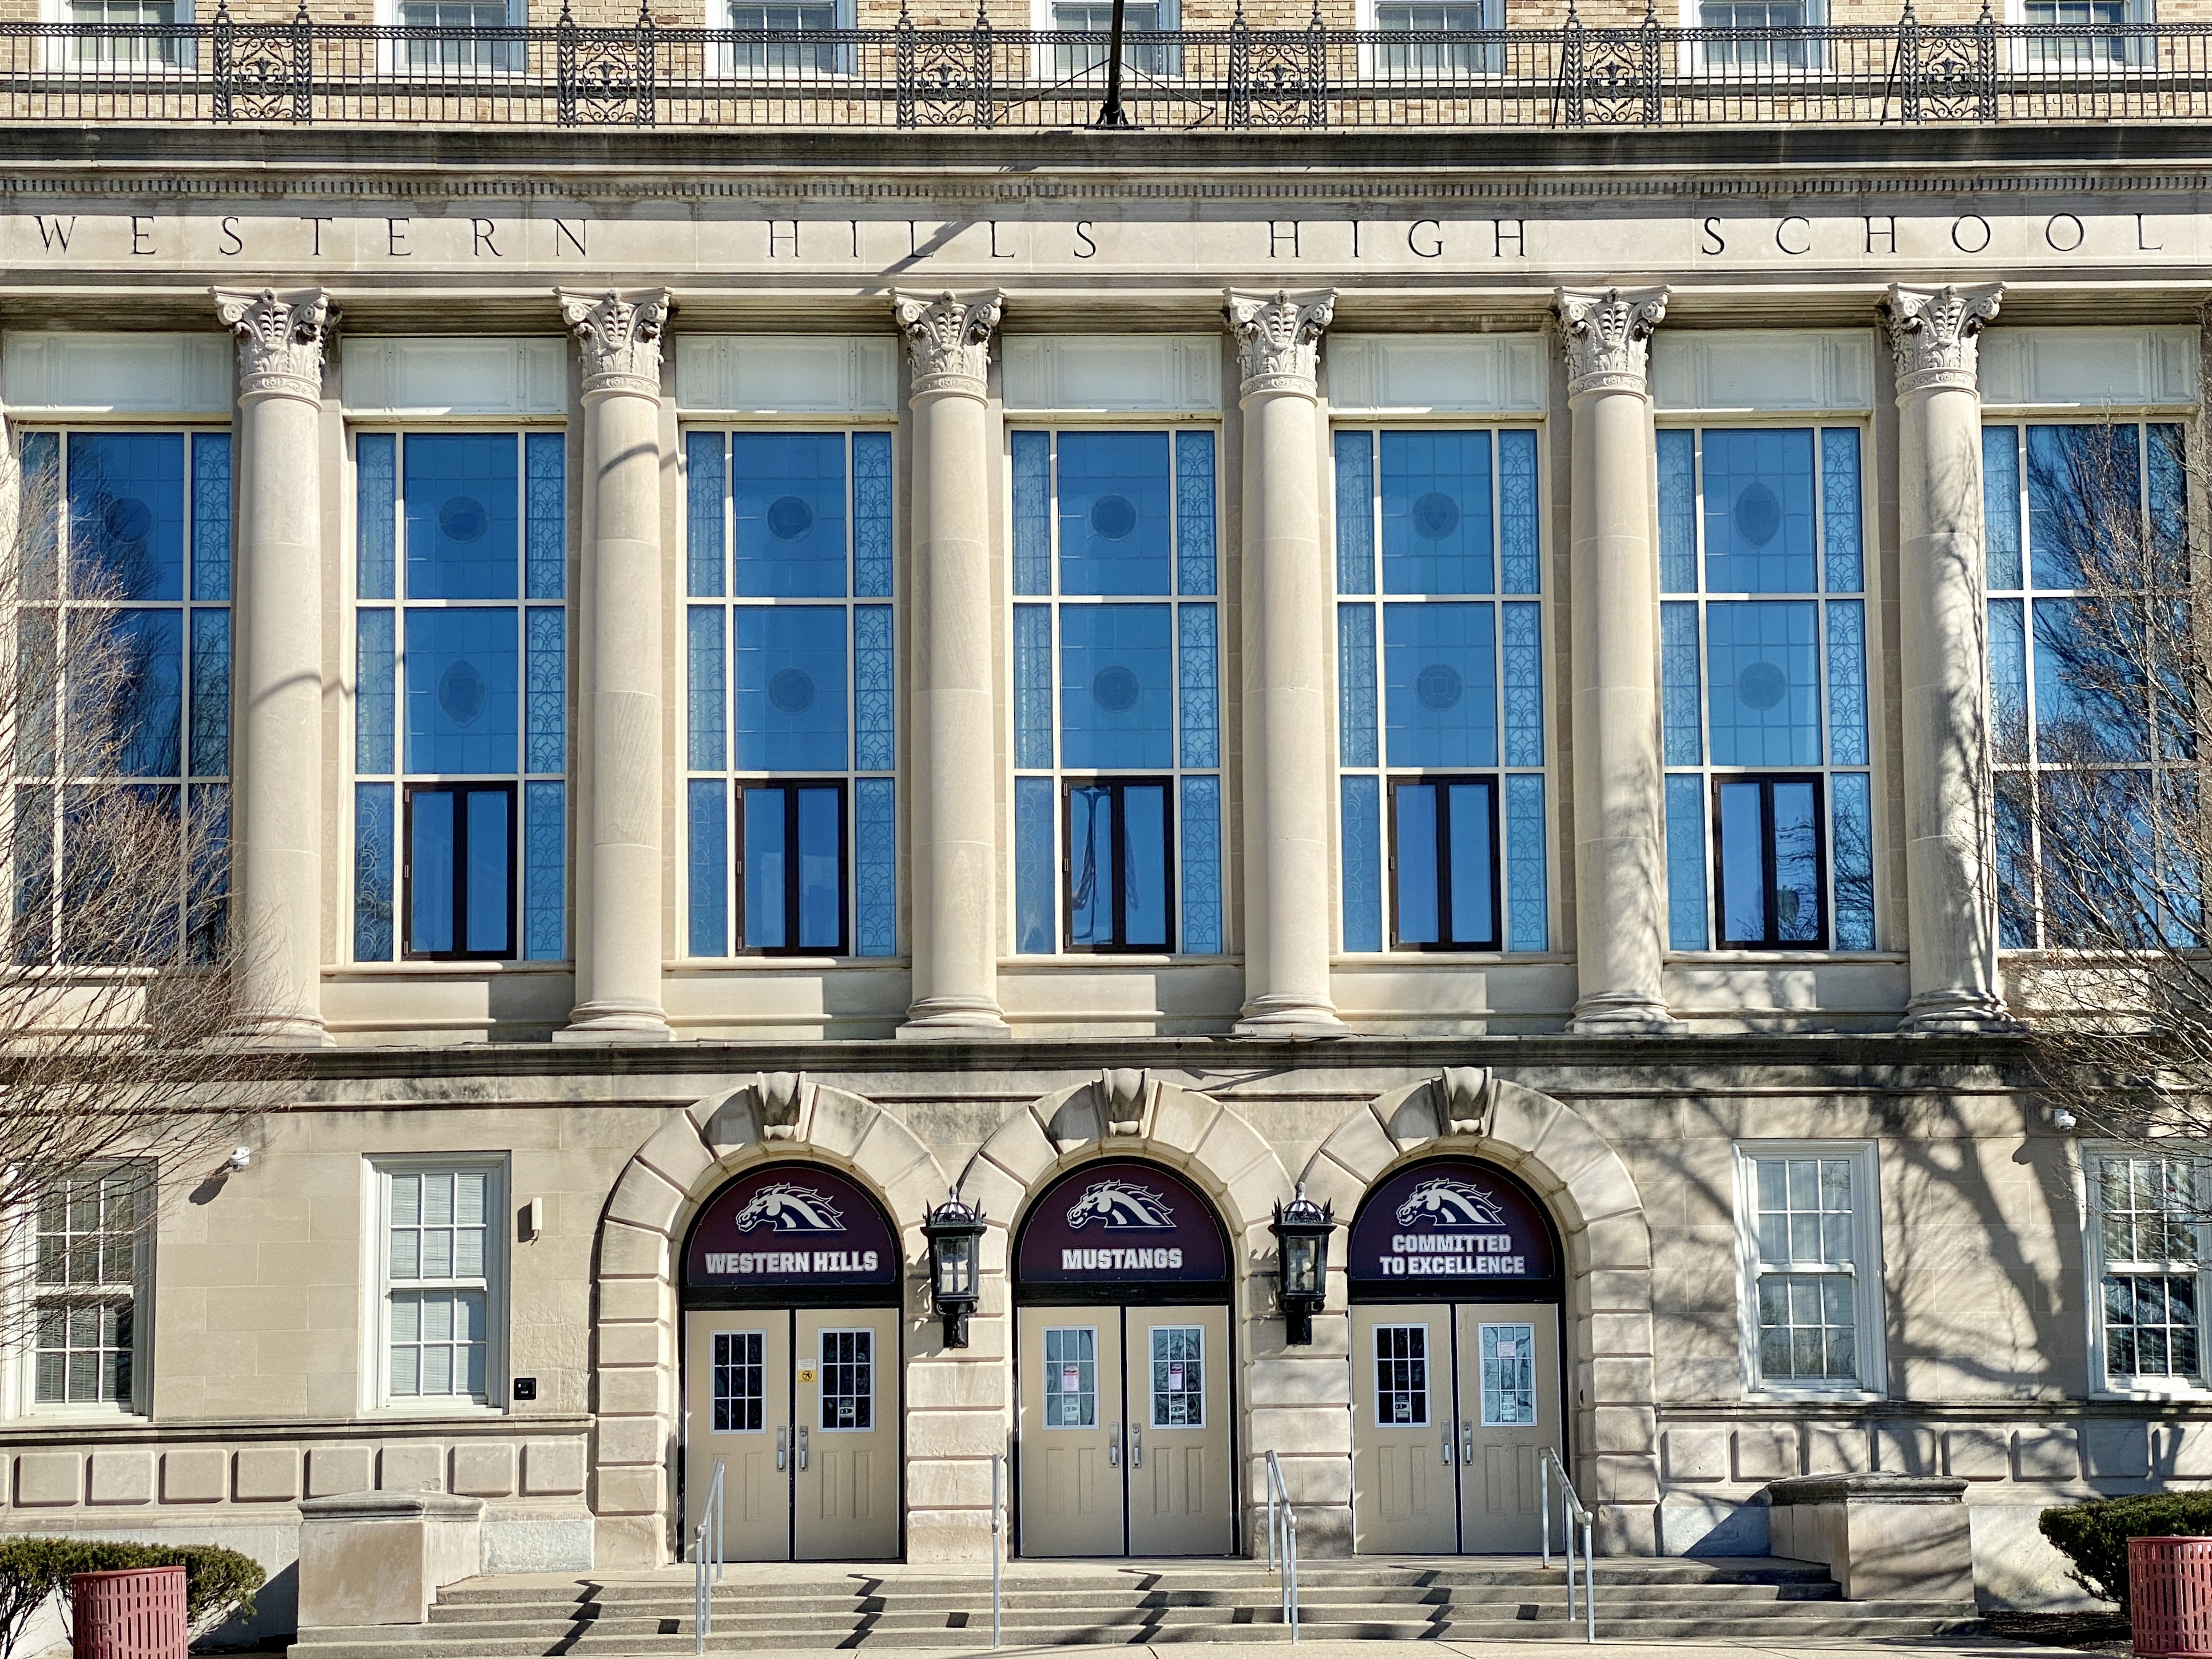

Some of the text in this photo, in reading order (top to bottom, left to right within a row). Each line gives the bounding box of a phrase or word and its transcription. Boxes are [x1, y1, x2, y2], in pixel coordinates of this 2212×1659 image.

[34, 212, 2164, 259] WESTERN HILLS HIGH SCHOOL
[1392, 1234, 1512, 1253] COMMITTED
[705, 1251, 878, 1274] WESTERN HILLS
[1062, 1248, 1183, 1270] MUSTANGS
[1379, 1255, 1526, 1275] TO EXCELLENCE
